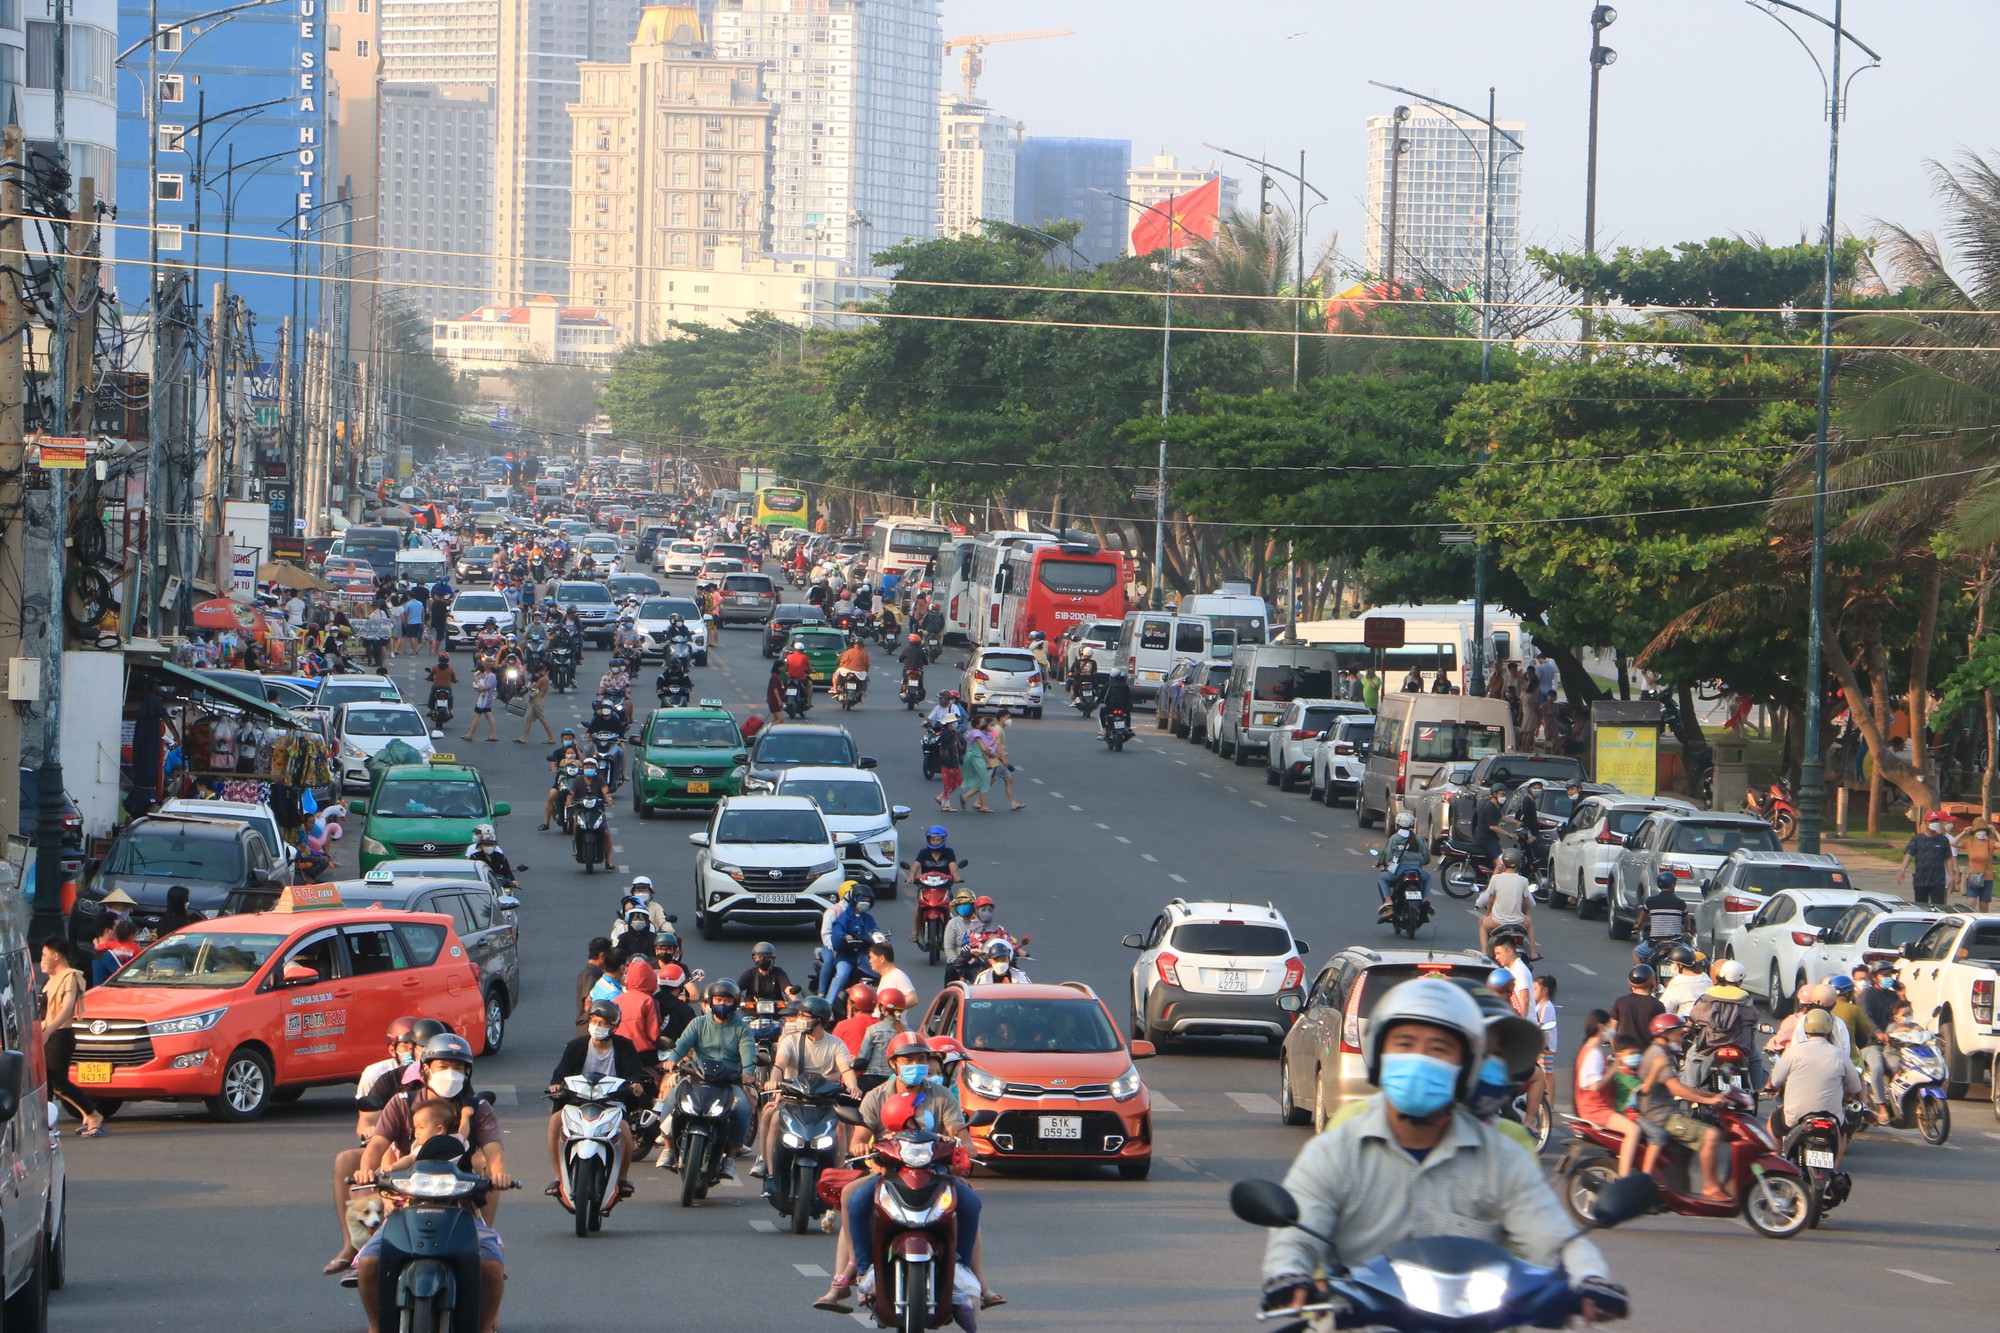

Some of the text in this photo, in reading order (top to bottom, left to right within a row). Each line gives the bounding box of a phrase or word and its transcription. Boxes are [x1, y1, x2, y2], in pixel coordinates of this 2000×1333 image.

[300, 52, 315, 112] SEA
[1412, 117, 1452, 128] TOWER
[299, 127, 315, 231] HOTEL
[269, 489, 286, 500] GS
[269, 500, 285, 512] 25
[269, 526, 284, 534] 24h
[368, 871, 390, 880] TAXI
[293, 887, 334, 900] FUTA TAXI
[1224, 972, 1240, 980] 72A
[303, 1009, 347, 1028] FUTA TAXI
[1051, 1118, 1070, 1127] 61K
[1044, 1128, 1077, 1138] 059.25
